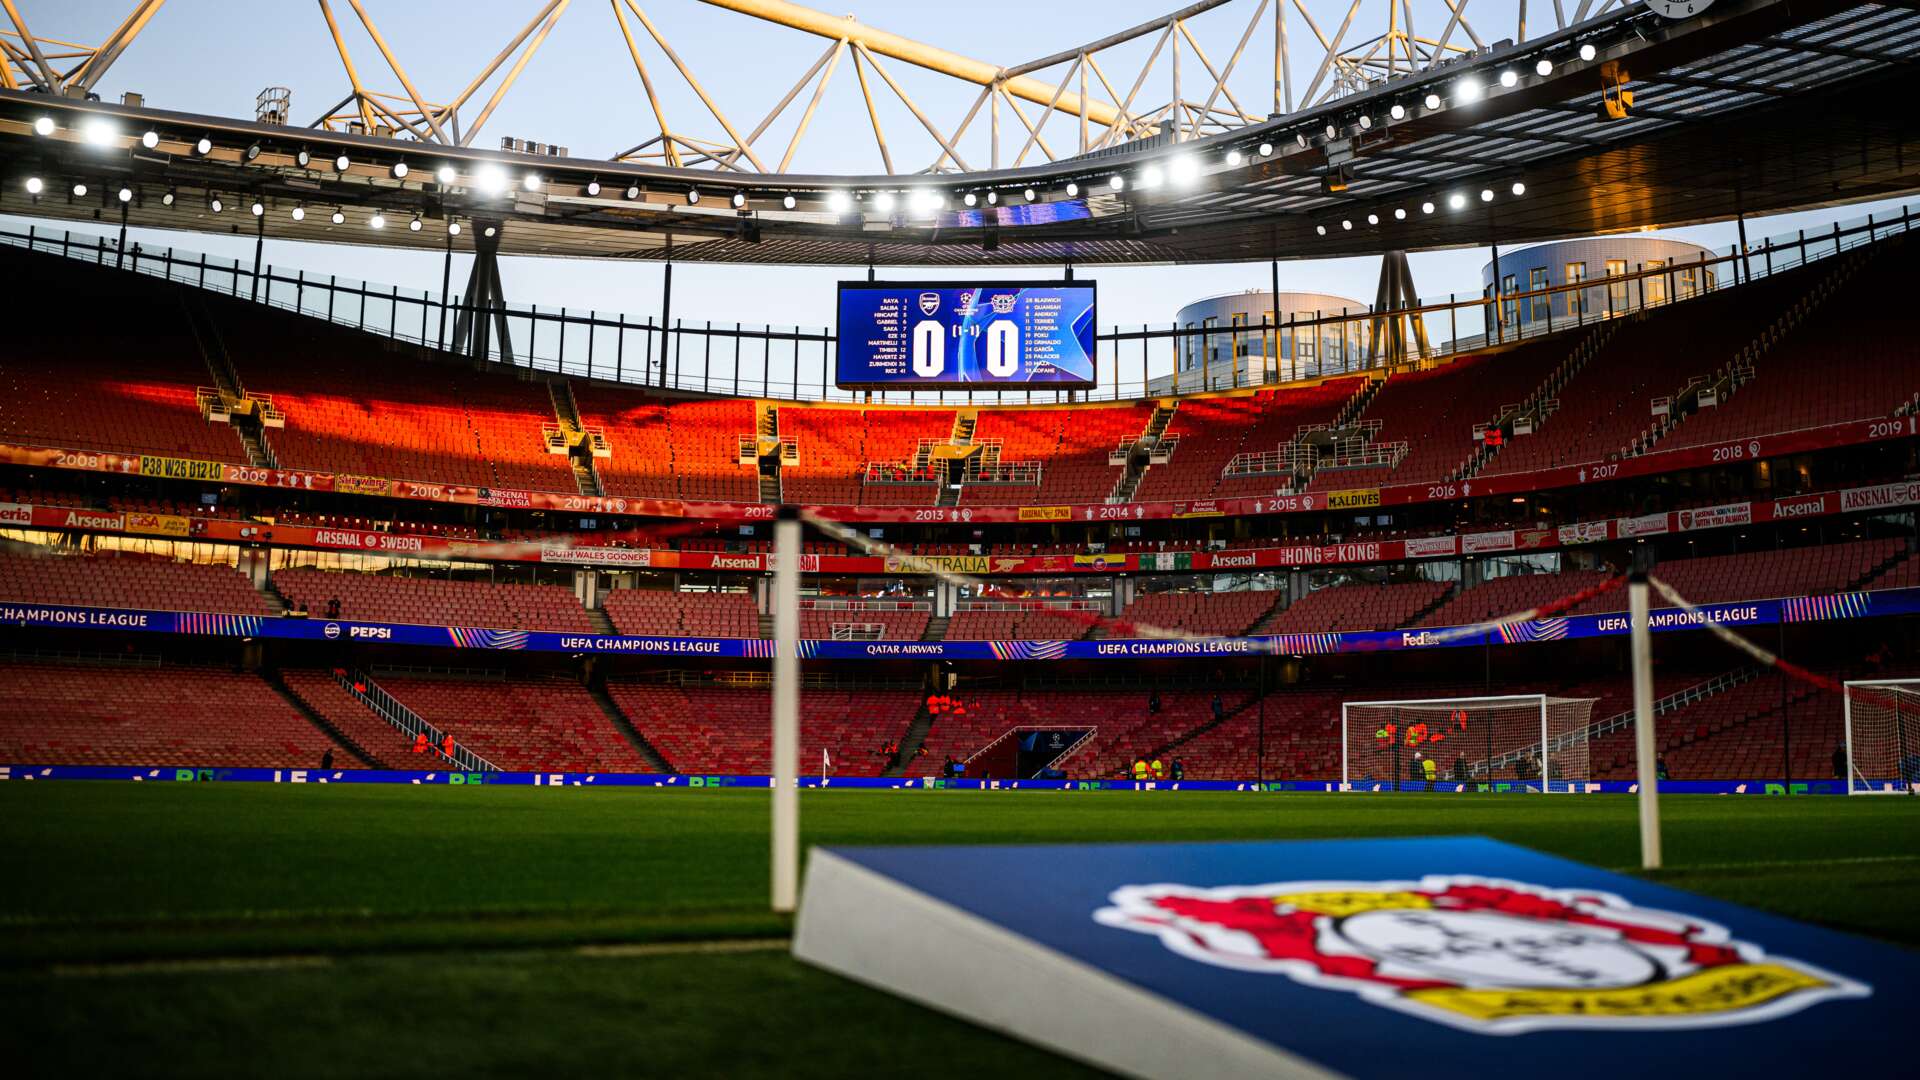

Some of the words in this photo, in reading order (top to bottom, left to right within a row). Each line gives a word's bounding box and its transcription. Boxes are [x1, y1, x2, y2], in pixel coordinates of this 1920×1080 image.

[1664, 4, 1670, 14] 7
[1687, 3, 1694, 14] 6
[913, 320, 944, 377] 0
[987, 320, 1018, 377] 0
[1868, 420, 1903, 438] 2019
[56, 453, 98, 468] 2008
[1712, 447, 1743, 462] 2018
[142, 457, 162, 475] P38
[164, 459, 187, 477] W26
[189, 461, 207, 478] D12
[1592, 464, 1619, 479] 2017
[230, 469, 268, 483] 2009
[410, 485, 441, 498] 2010
[1428, 484, 1456, 498] 2016
[1845, 489, 1893, 508] ARSENAL
[488, 497, 530, 507] MALAYSIA
[564, 498, 590, 509] 2011
[1269, 499, 1297, 511] 2015
[1328, 494, 1380, 508] MALDIVES
[1773, 496, 1824, 519] Arsenal
[744, 506, 774, 518] 2012
[915, 510, 944, 520] 2013
[1100, 507, 1129, 519] 2014
[64, 511, 125, 529] Arsenal
[315, 530, 361, 546] ARSENAL
[380, 536, 423, 551] SWEDEN
[543, 549, 573, 558] SOUTH
[575, 551, 605, 560] WALES
[606, 552, 649, 561] GOONERS
[1211, 552, 1256, 567] Arsenal
[1285, 547, 1322, 564] HONG
[1339, 544, 1375, 561] KONG
[711, 555, 760, 569] Arsenal
[900, 557, 988, 573] AUSTRALIA
[90, 612, 148, 627] LEAGUE
[1598, 618, 1628, 631] UEFA
[1707, 607, 1758, 623] LEAGUE
[350, 626, 391, 639] PEPSI
[561, 637, 593, 649] UEFA
[596, 639, 670, 652] CHAMPIONS
[672, 640, 720, 653] LEAGUE
[866, 644, 901, 654] QATAR
[901, 644, 943, 654] AIRWAYS
[1098, 644, 1128, 655] UEFA
[1131, 642, 1201, 654] CHAMPIONS
[1203, 640, 1248, 652] LEAGUE
